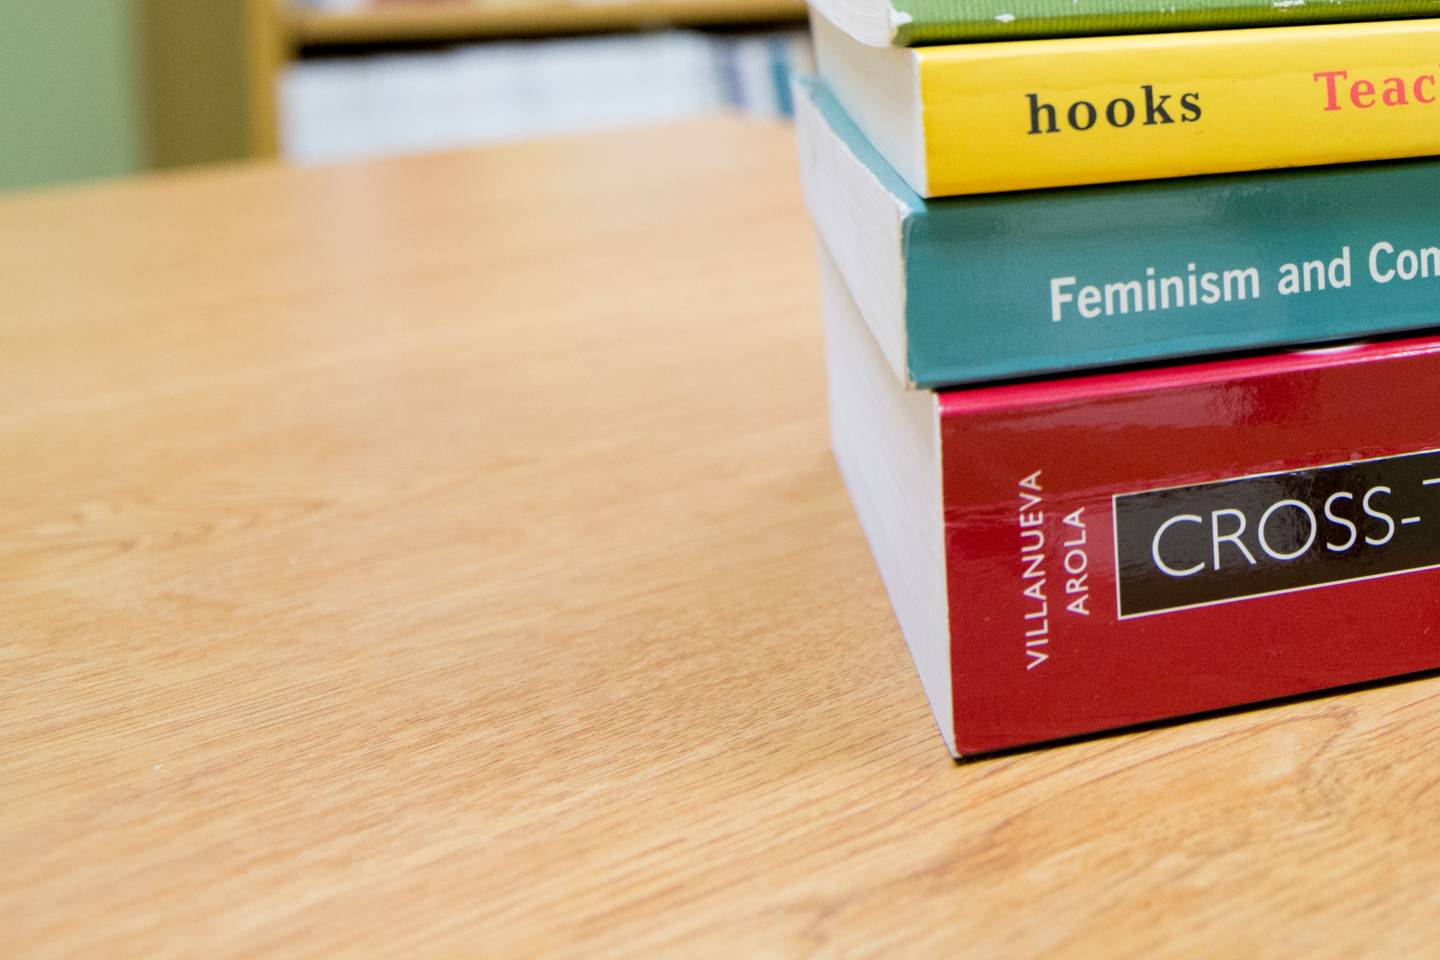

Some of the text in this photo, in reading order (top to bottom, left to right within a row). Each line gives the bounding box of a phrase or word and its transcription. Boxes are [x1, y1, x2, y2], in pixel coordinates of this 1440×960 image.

[1025, 84, 1202, 134] hooks
[1050, 263, 1260, 321] Feminism
[1278, 246, 1351, 296] and
[1018, 470, 1049, 671] VILLANUEVA
[1065, 507, 1090, 616] AROLA
